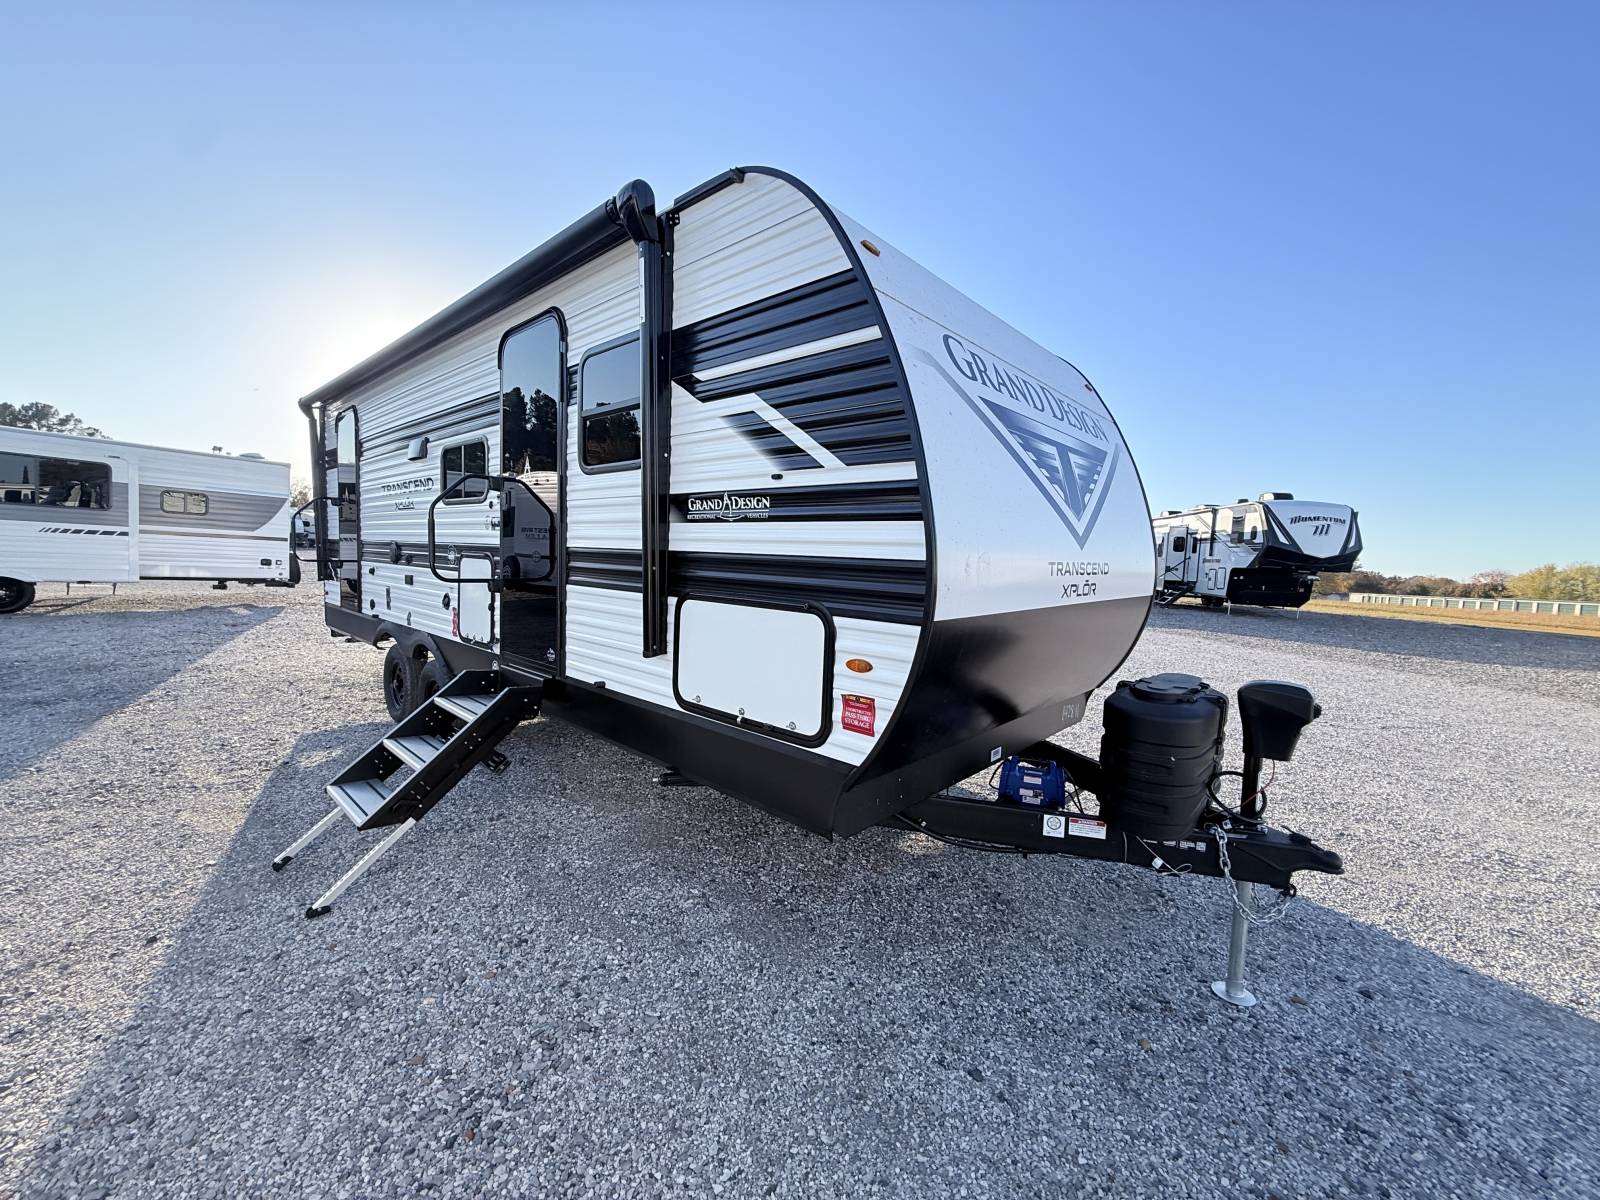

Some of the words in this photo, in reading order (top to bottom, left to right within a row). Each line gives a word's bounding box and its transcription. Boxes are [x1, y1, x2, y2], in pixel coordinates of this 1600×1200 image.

[942, 333, 1045, 413] GRAND
[1038, 384, 1110, 444] DESIGN
[381, 476, 434, 497] TRANSCEND
[688, 498, 723, 511] GRAND
[730, 496, 770, 509] DESIGN
[1048, 561, 1110, 577] TRANSCEND
[844, 718, 870, 729] STORAGE
